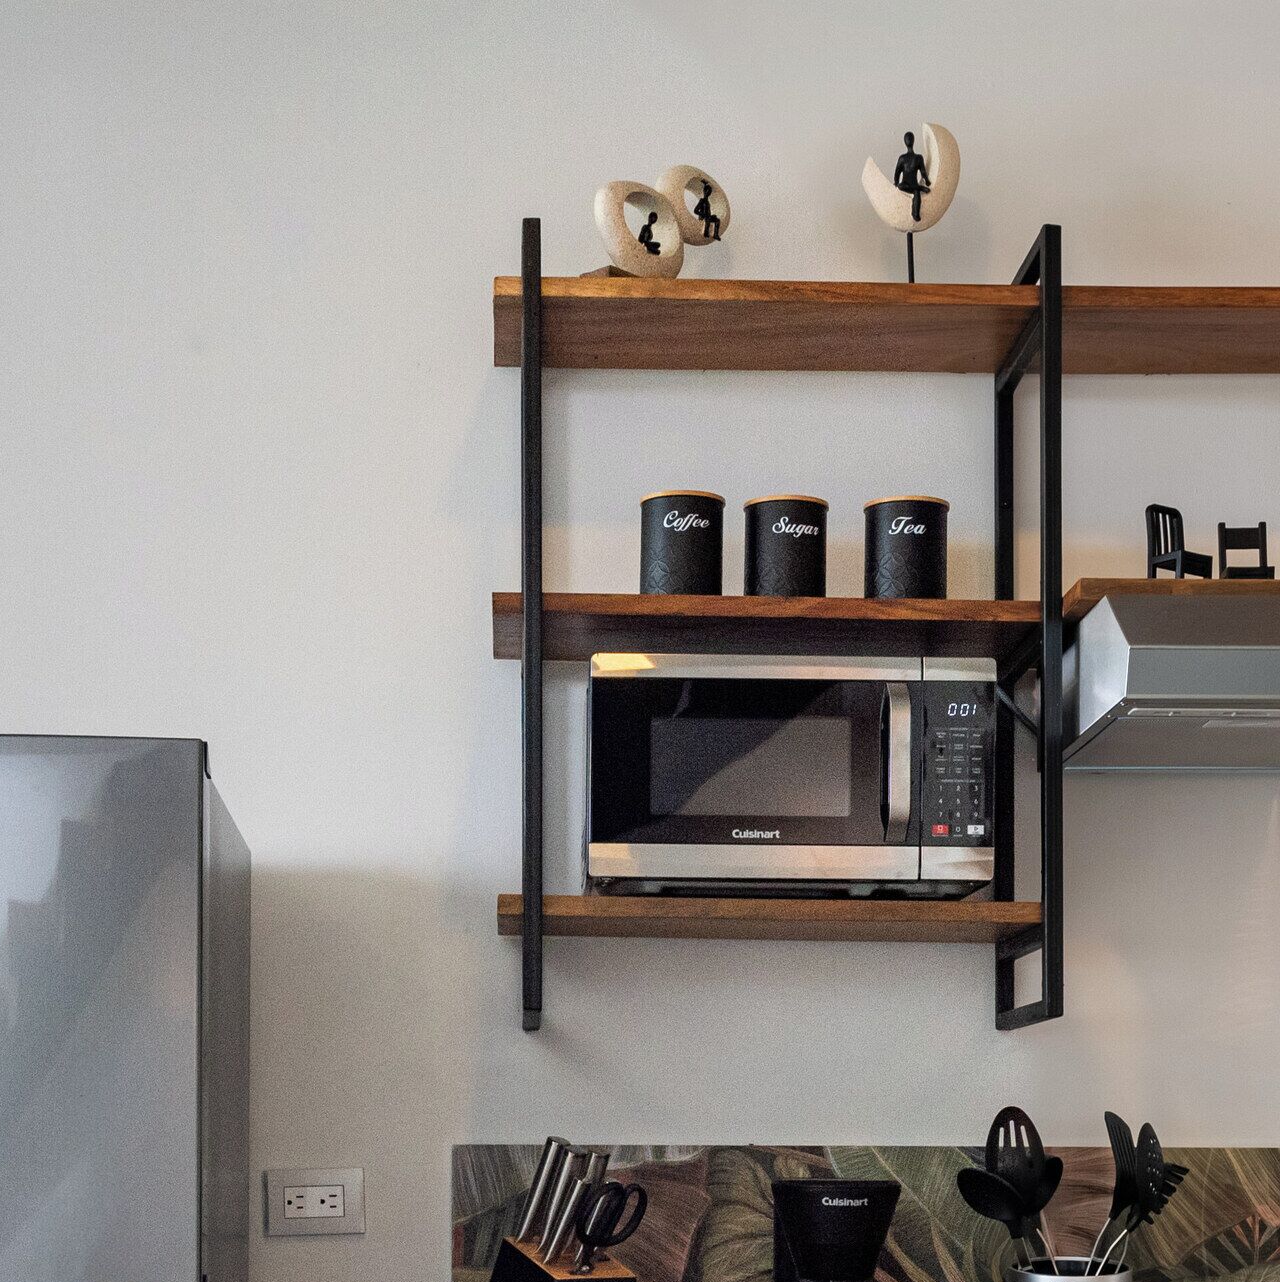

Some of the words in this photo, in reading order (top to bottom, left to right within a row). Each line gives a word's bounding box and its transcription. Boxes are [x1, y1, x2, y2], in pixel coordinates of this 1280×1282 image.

[663, 510, 710, 532] Coffee
[772, 516, 819, 537] Sugar
[888, 516, 927, 535] Tea
[731, 828, 781, 840] Cuisinart
[821, 1196, 869, 1207] Cuisinart
